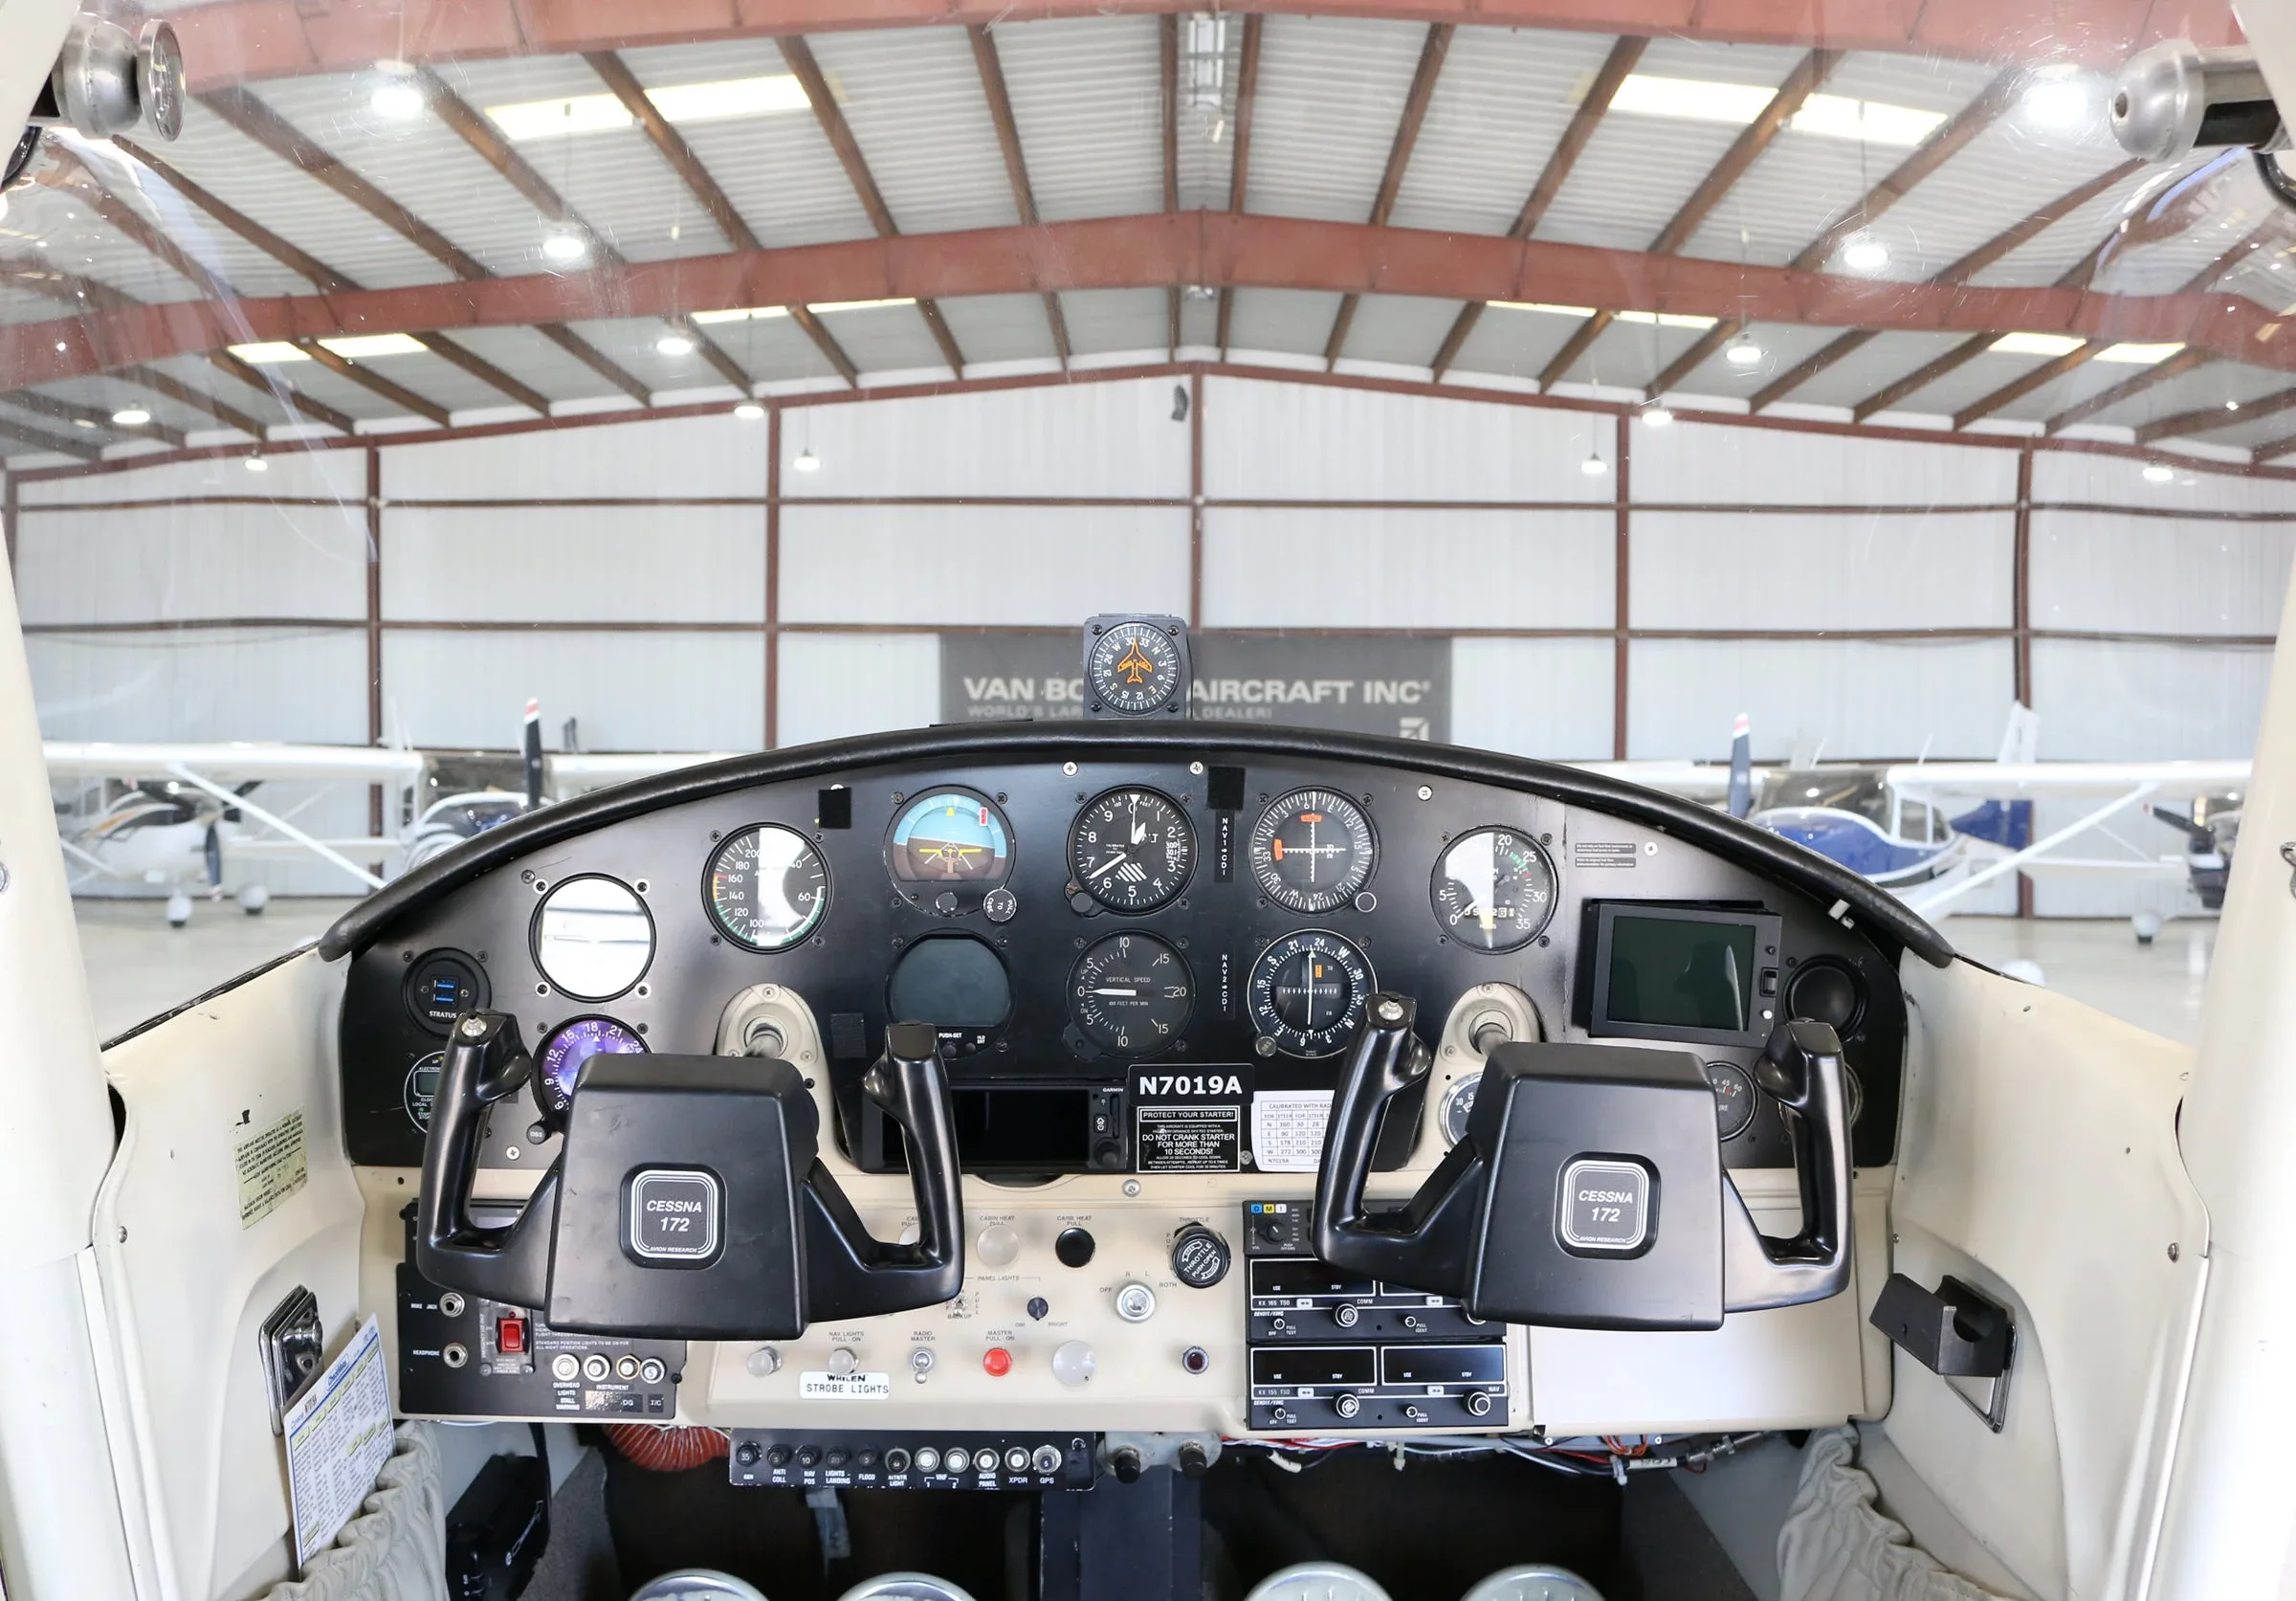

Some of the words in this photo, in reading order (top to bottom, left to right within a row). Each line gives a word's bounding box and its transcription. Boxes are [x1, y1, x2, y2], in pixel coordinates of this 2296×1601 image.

[1125, 637, 1135, 647] 30
[1138, 637, 1150, 648] 33
[1151, 646, 1161, 656] N
[1104, 654, 1114, 665] 24
[1103, 669, 1113, 678] 21
[962, 677, 1035, 701] VAN
[1186, 678, 1355, 703] AIRCRAFT
[1120, 690, 1130, 700] 15
[1136, 691, 1144, 700] 12
[1104, 810, 1114, 822] 9
[1345, 818, 1355, 829] 12
[1088, 832, 1097, 843] 8
[1167, 826, 1177, 838] 2
[1267, 828, 1275, 838] N
[1498, 834, 1512, 846] 20
[1086, 856, 1095, 868] 7
[1263, 851, 1272, 862] 33
[1522, 851, 1537, 862] 25
[735, 861, 750, 871] 180
[1167, 860, 1176, 873] 3
[728, 874, 743, 883] 160
[1103, 877, 1113, 889] 6
[1152, 878, 1162, 888] 4
[1270, 873, 1281, 885] 30
[729, 891, 744, 901] 140
[798, 892, 811, 902] 60
[1127, 885, 1137, 898] 5
[1439, 889, 1447, 901] 5
[1533, 891, 1548, 903] 30
[734, 907, 749, 918] 120
[749, 919, 765, 928] 100
[1449, 914, 1458, 926] 0
[1515, 918, 1531, 930] 35
[1119, 937, 1131, 948] 10
[1288, 940, 1299, 950] 21
[1314, 937, 1325, 947] 24
[1337, 945, 1351, 959] W
[1086, 957, 1094, 969] 5
[1159, 953, 1170, 964] 15
[1267, 955, 1278, 966] S
[1353, 967, 1364, 981] 30
[1256, 979, 1267, 990] 15
[1172, 987, 1187, 997] 20
[429, 1010, 457, 1019] STRATUS
[1258, 1005, 1269, 1016] 12
[1086, 1014, 1094, 1026] 5
[1344, 1018, 1355, 1030] N
[585, 1021, 599, 1033] 18
[608, 1024, 624, 1038] 21
[1159, 1023, 1169, 1034] 15
[1273, 1026, 1284, 1037] E
[562, 1029, 575, 1043] 15
[1117, 1035, 1129, 1047] 10
[1324, 1034, 1333, 1044] 3
[629, 1040, 644, 1054] 24
[546, 1048, 560, 1063] 12
[1139, 1076, 1244, 1096] N7019A
[1455, 1097, 1464, 1106] 30
[1578, 1190, 1634, 1204] CESSNA
[646, 1200, 703, 1213] CESSNA
[1591, 1207, 1621, 1223] 172
[660, 1216, 691, 1233] 172
[1183, 1242, 1213, 1273] THROTTLE
[1191, 1262, 1205, 1278] PUSH
[1203, 1249, 1217, 1265] OPEN
[806, 1383, 844, 1393] STROBE
[850, 1384, 889, 1394] LIGHTS
